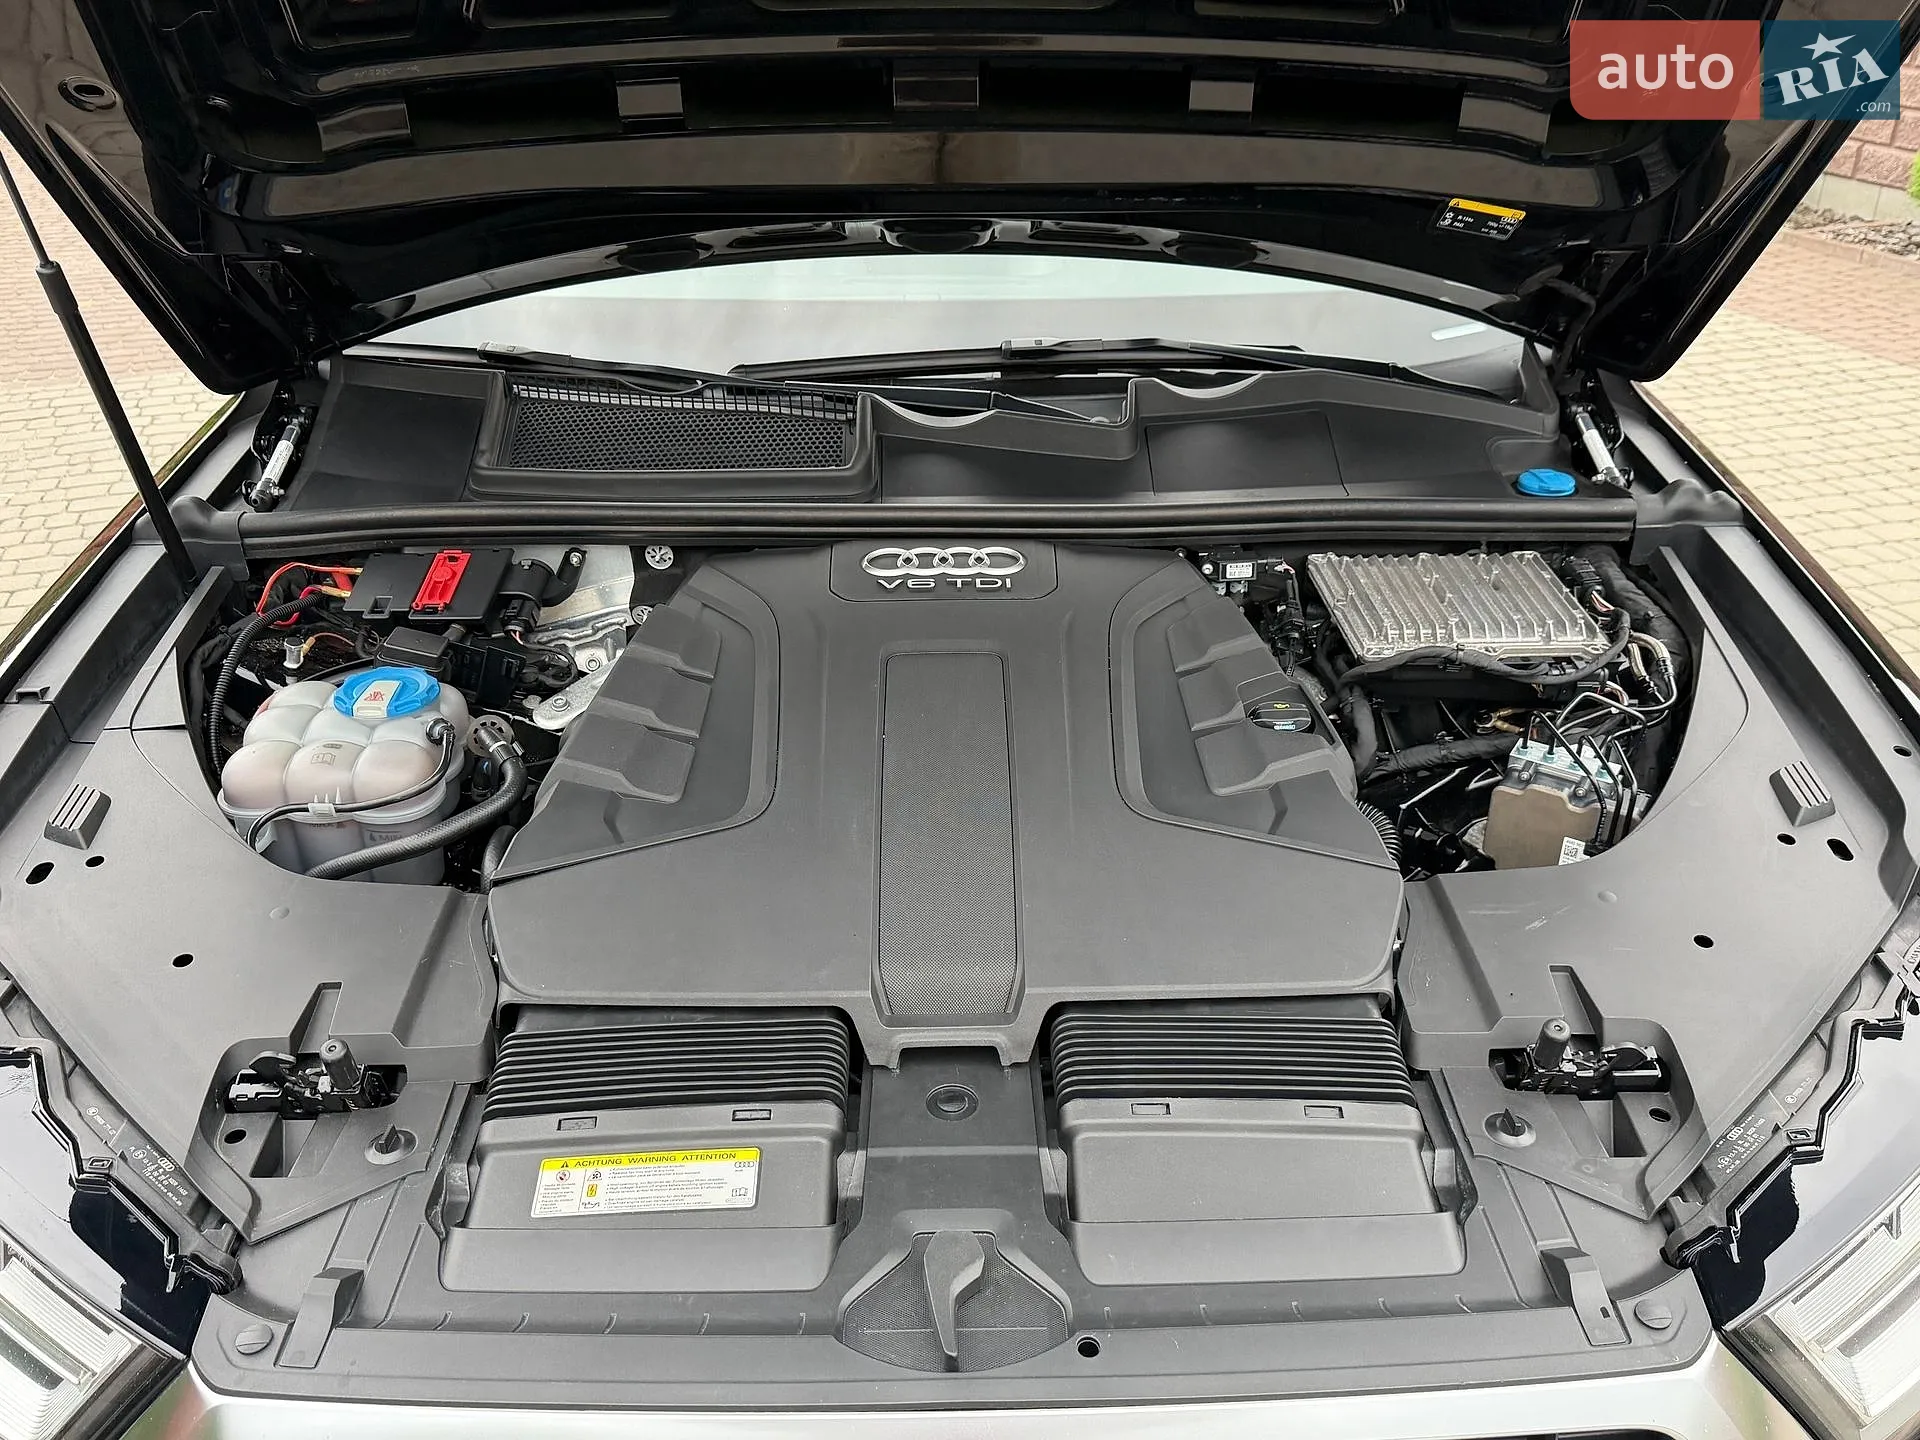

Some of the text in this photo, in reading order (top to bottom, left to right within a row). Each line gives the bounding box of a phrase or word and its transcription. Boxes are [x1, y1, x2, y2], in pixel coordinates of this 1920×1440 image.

[876, 578, 1012, 589] V6 TDI
[574, 1153, 737, 1167] ACHTUNG WARNING ATTENTION
